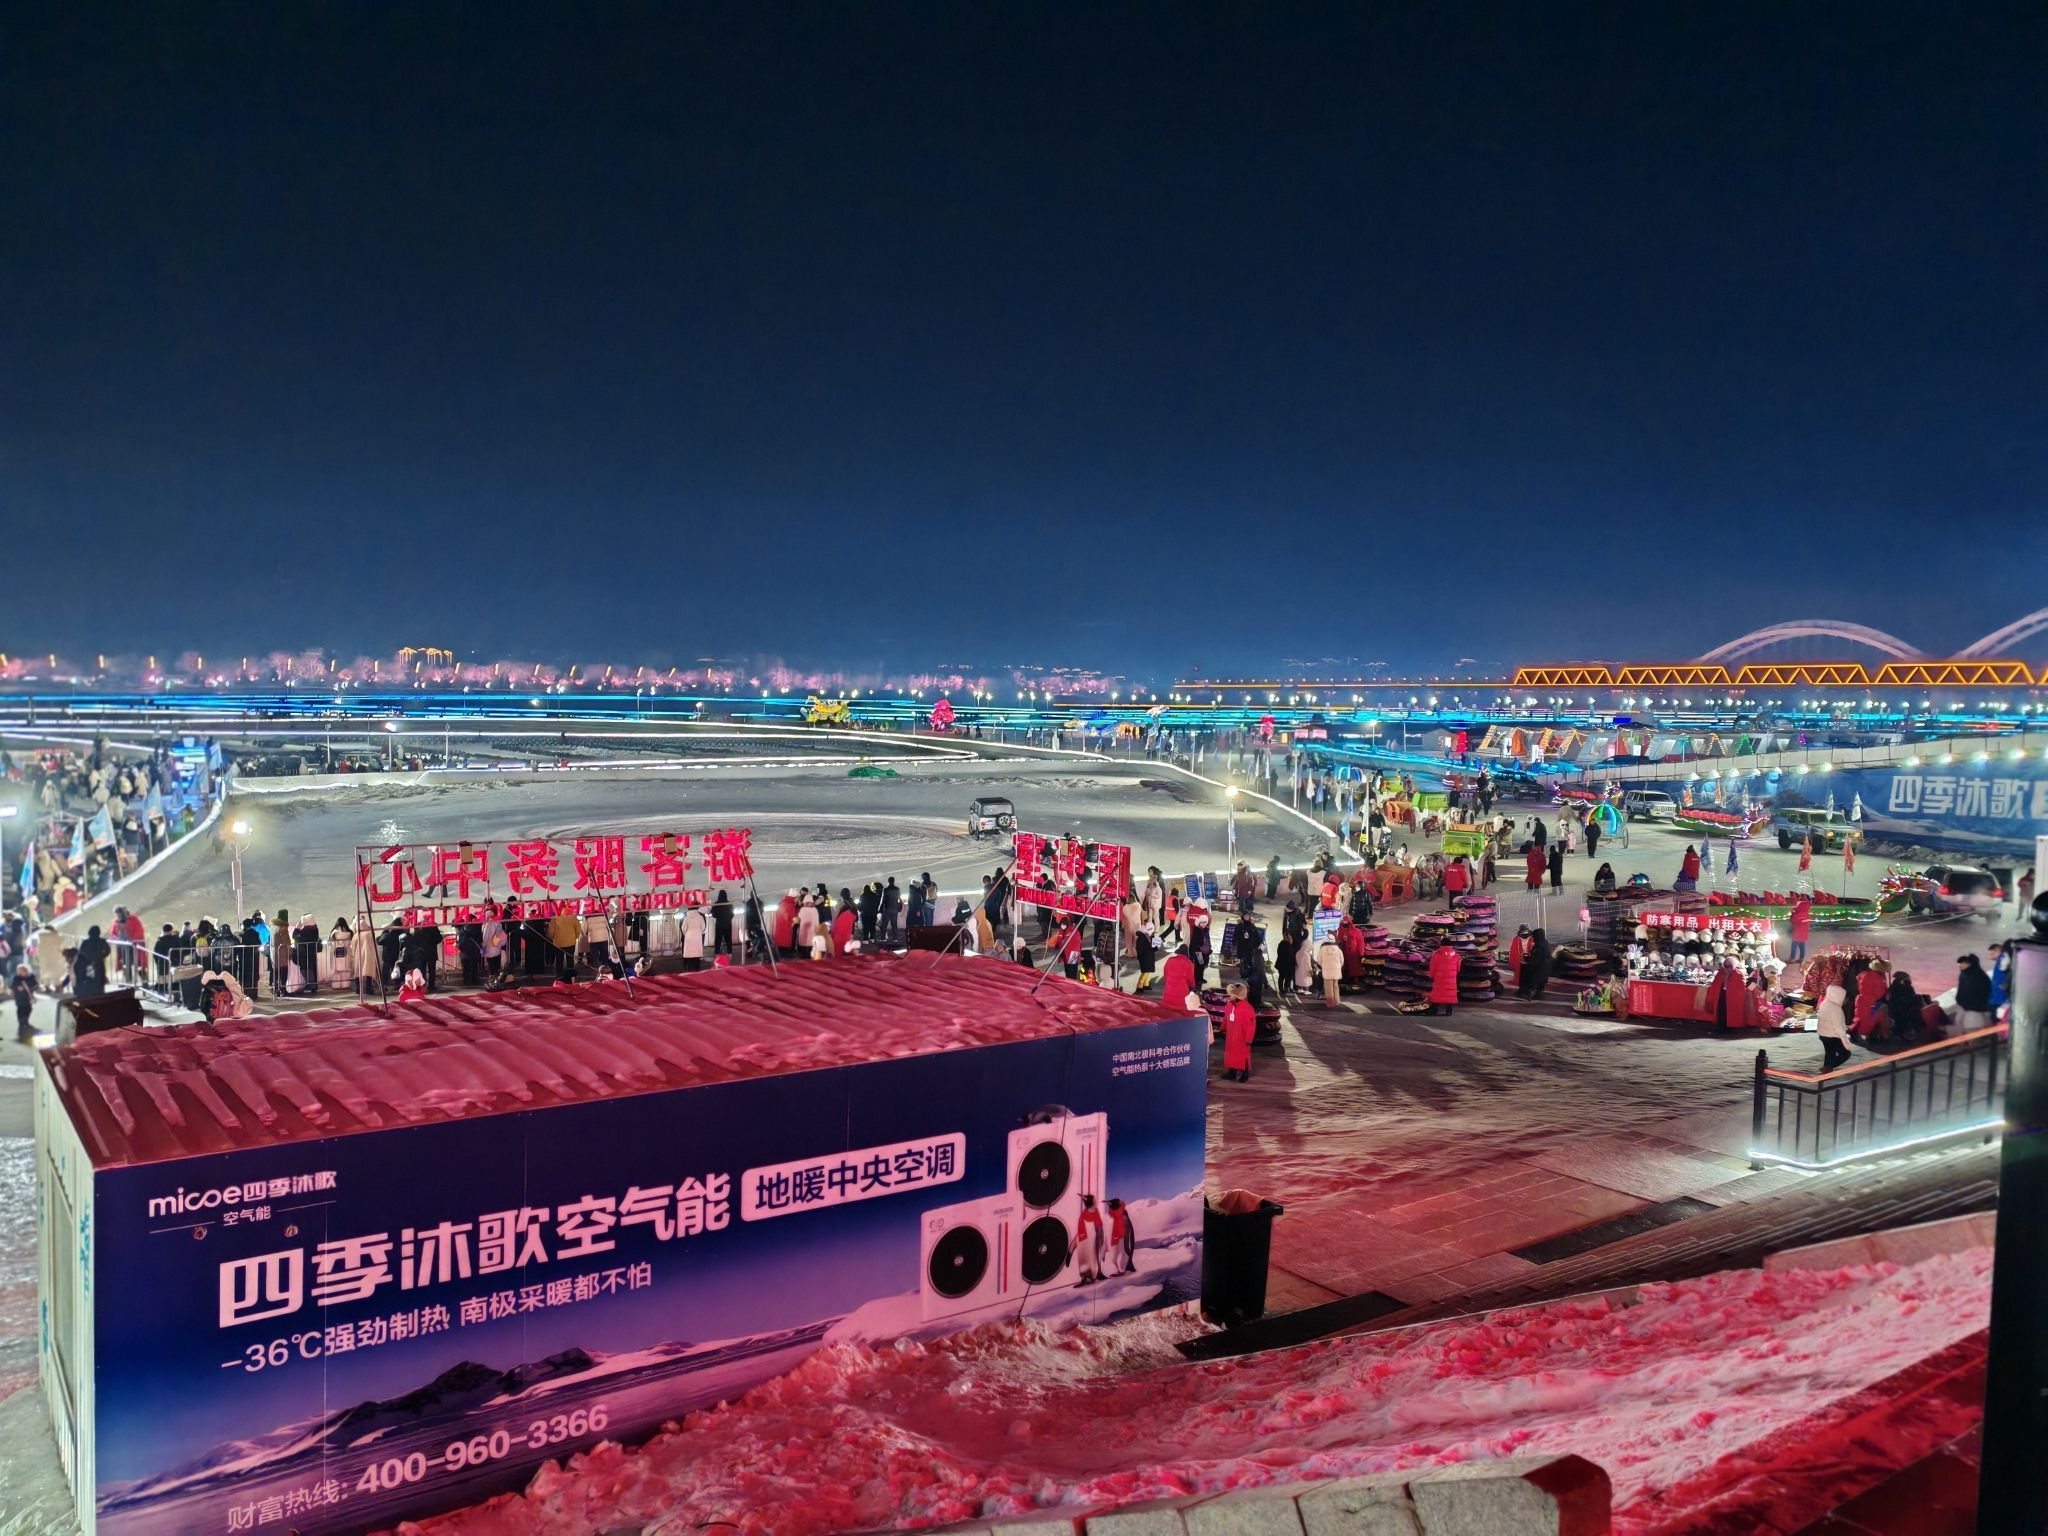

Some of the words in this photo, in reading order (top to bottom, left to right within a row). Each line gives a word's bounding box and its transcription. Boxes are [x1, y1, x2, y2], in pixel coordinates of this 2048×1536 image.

[1889, 775, 2031, 819] 四季沐歌
[1646, 914, 1699, 929] 防寒用品
[1708, 917, 1763, 933] 出租大衣
[218, 1172, 731, 1329] 四季沐歌空气能
[755, 1142, 956, 1211] 地暖中央空调
[223, 1206, 272, 1226] 空气能
[460, 1261, 652, 1326] 南极采暖都不怕
